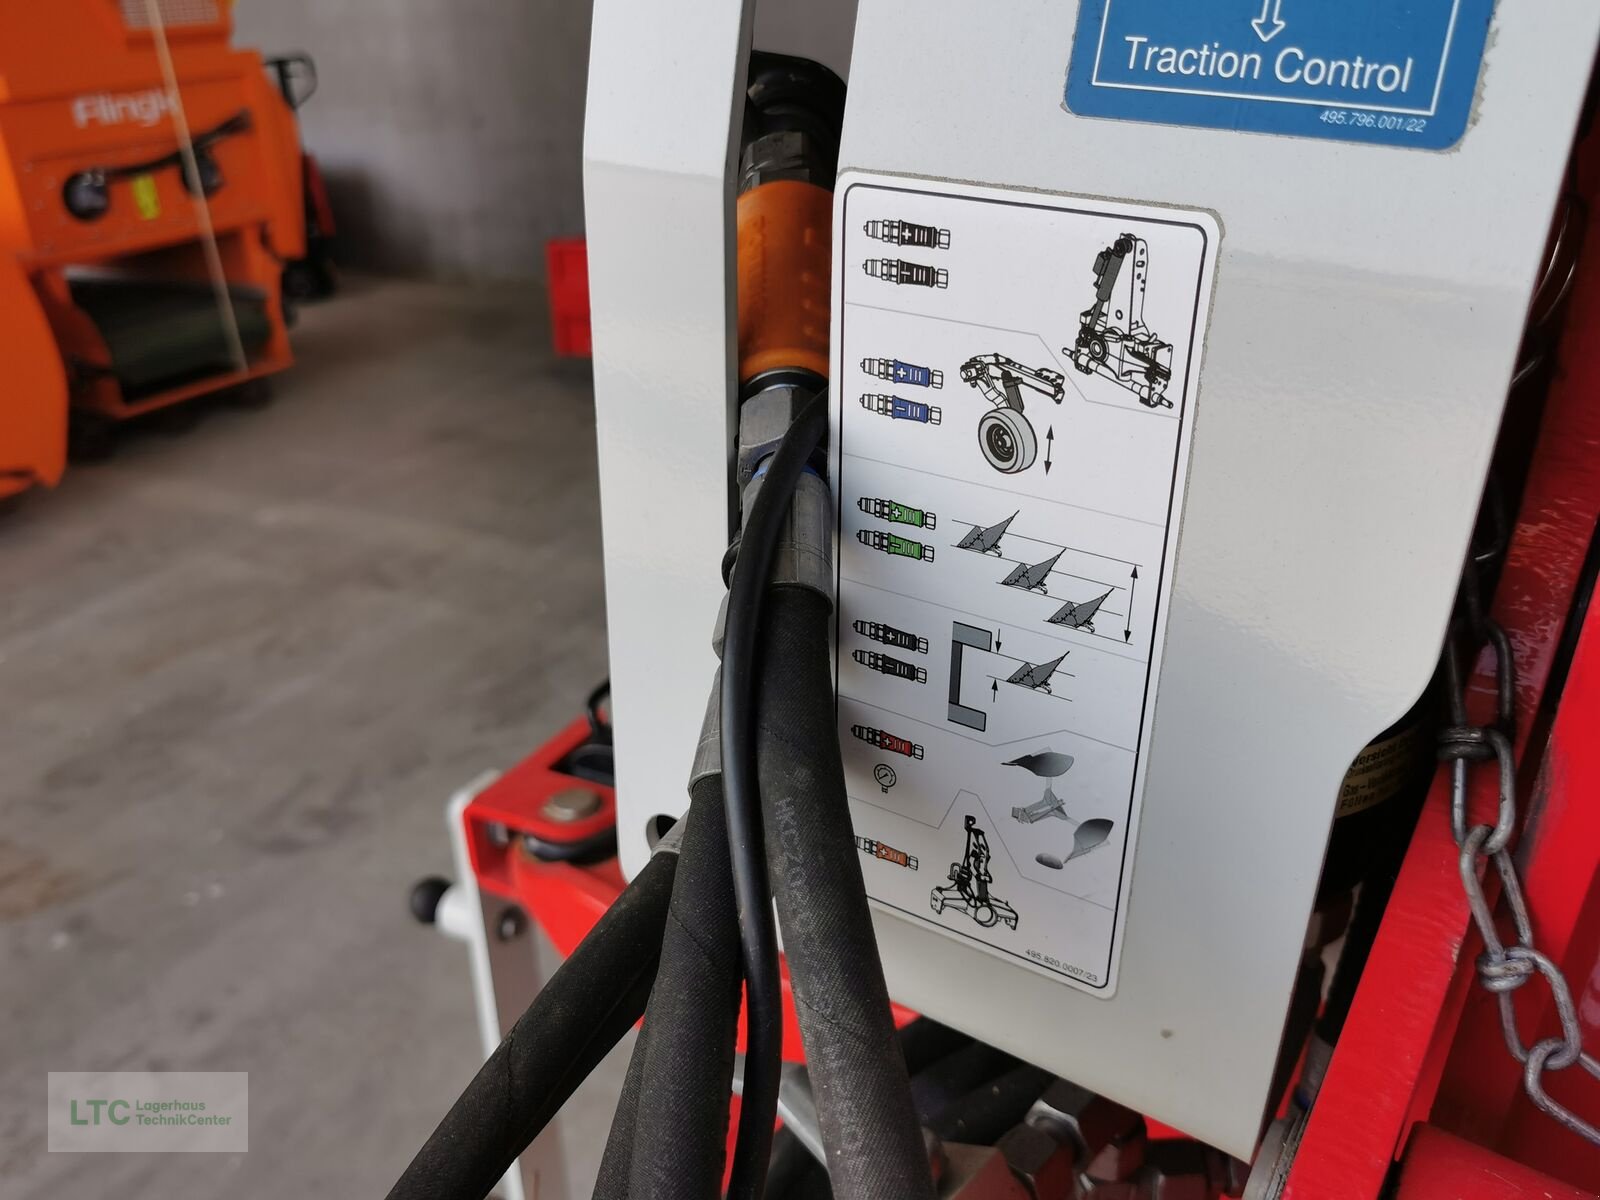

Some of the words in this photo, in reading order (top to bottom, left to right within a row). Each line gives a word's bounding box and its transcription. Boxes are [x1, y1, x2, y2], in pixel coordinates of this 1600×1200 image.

[1125, 36, 1262, 80] Traction
[1275, 47, 1414, 93] Control
[1319, 110, 1427, 133] 495.796.001/22
[1025, 949, 1098, 982] 495.820.0007/23
